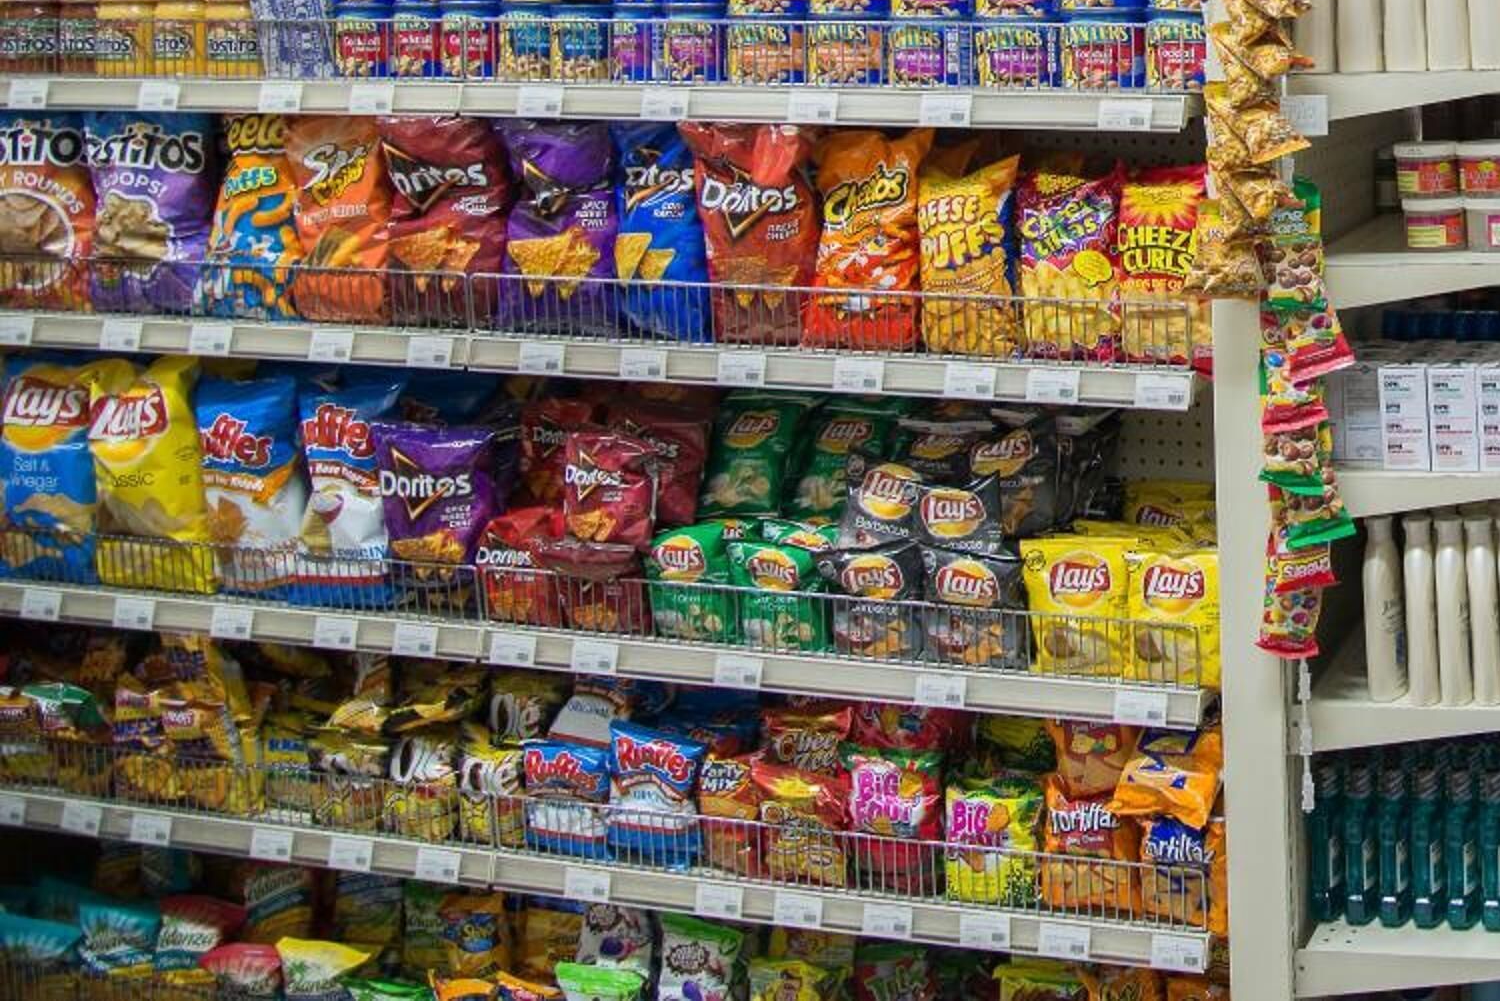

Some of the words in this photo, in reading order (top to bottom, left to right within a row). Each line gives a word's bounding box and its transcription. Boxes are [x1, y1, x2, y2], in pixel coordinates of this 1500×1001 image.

[13, 171, 84, 213] ROUNDS
[702, 178, 798, 212] Doritos
[1123, 247, 1195, 276] CURLS
[4, 377, 85, 429] Lay's
[13, 456, 38, 472] Salt
[381, 469, 472, 499] Doritos
[928, 495, 978, 524] Lay's
[855, 516, 909, 537] Barbecue
[848, 563, 899, 587] Lay's
[943, 568, 994, 598] Lay's
[1054, 558, 1110, 594] Lay's
[1146, 567, 1203, 601] Lay's
[523, 750, 598, 790] Ruffles
